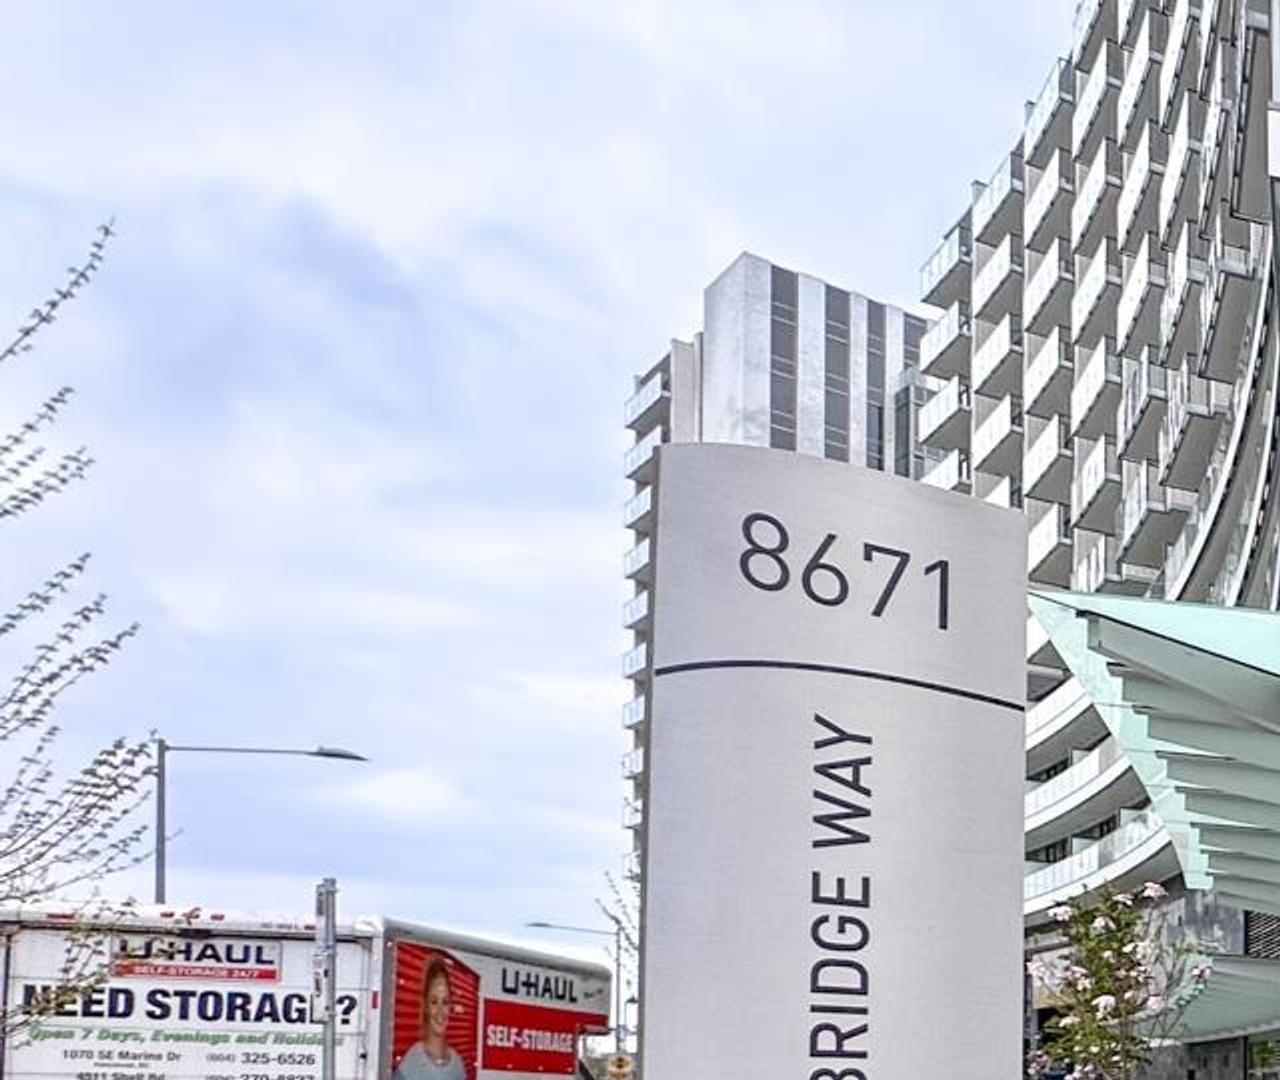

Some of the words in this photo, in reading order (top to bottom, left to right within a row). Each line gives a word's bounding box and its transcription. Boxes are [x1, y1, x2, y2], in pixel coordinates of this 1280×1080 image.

[739, 512, 950, 631] 8671
[812, 712, 873, 849] WAY
[22, 983, 135, 1020] NEED
[145, 988, 358, 1026] STORAG?
[32, 1029, 75, 1041] Open
[81, 1028, 93, 1040] 7
[151, 1030, 231, 1044] Evenings
[235, 1031, 270, 1044] and
[486, 1024, 574, 1052] SELF-STORAGE
[63, 1049, 95, 1060] 1070
[97, 1050, 114, 1061] SE
[117, 1051, 163, 1062] Marine
[166, 1052, 183, 1062] Dr
[241, 1052, 316, 1066] 325-6526
